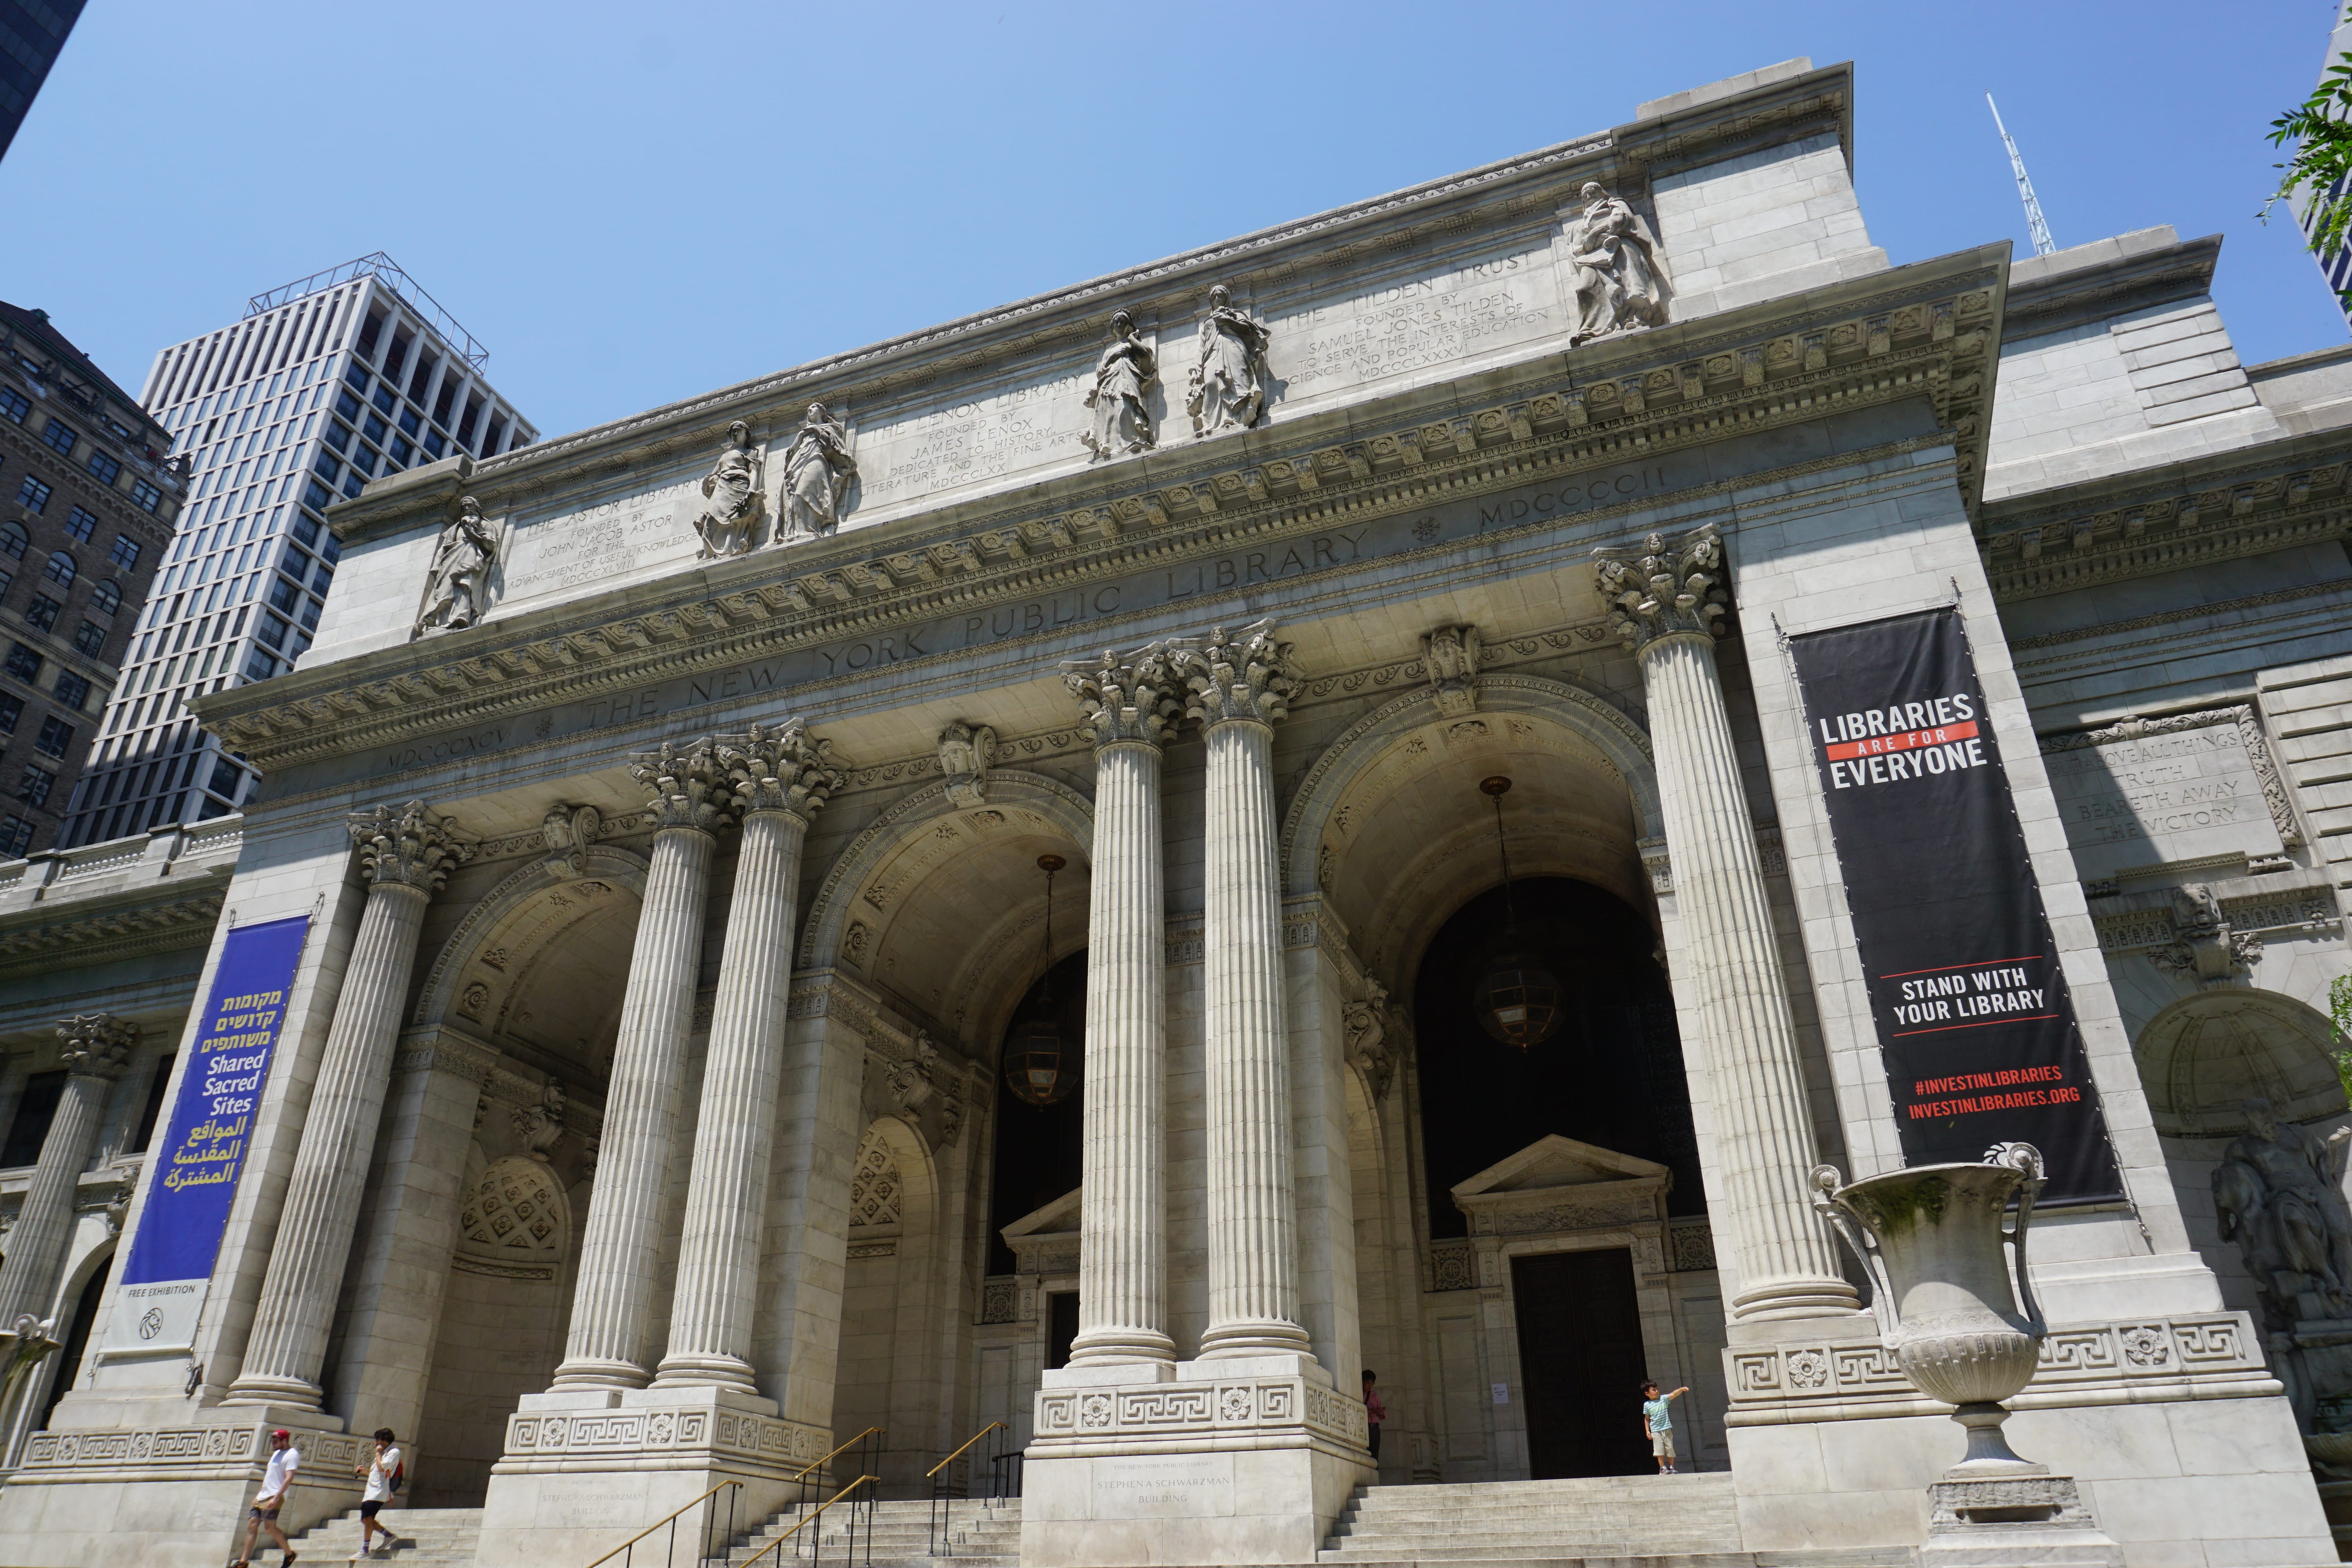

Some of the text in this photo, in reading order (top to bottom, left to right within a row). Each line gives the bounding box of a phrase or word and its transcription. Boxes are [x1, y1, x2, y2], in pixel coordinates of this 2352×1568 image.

[1280, 249, 1534, 330] THE TILDEN TRUST
[1308, 291, 1514, 354] SAMUEL JONES TILDEN
[1356, 293, 1458, 328] FOUNDED BY
[1282, 310, 1549, 387] SCIENCE AND POPULAR EDUCATION
[1298, 303, 1523, 370] TO SERVE THE INTERESTS OF
[1358, 344, 1468, 381] MDCCCLXXXVI
[870, 372, 1083, 442] THE LENOX LIBRARY
[910, 418, 1032, 459] JAMES LENOX
[928, 411, 1016, 442] FOUNDED BY
[860, 431, 1082, 497] LITERATURE AND THE FINE ARTS
[890, 452, 958, 477] DEDICATED
[967, 445, 984, 457] TO
[929, 463, 1006, 490] MDCCCLXX
[526, 475, 704, 537] THE ASTOR LIBRARY
[539, 515, 672, 559] JOHN JACOB ASTOR
[571, 512, 645, 539] FOUNDED BY
[508, 532, 697, 589] ADVANCEMENT OF USEFUL KNOWLEDGE
[578, 540, 625, 559] FOR THE
[561, 559, 635, 586] MDCCCXLVIII
[385, 466, 1665, 770] MDCCCXCV THE NEW YORK PUBLIC LIBRARY MDCCCCII
[1820, 693, 1974, 744] LIBRARIES
[1858, 729, 1946, 755] ARE FOR
[2050, 732, 2237, 776] BUT ABOVE ALL THINGS
[1830, 738, 1987, 789] EVERYONE
[2112, 765, 2185, 789] TRUTH
[2078, 780, 2238, 819] BEARETH AWAY
[2095, 806, 2238, 841] THE VICTORY
[1902, 967, 2027, 1000] STAND WITH
[221, 991, 281, 1012] מקומות
[1893, 989, 2044, 1025] YOUR LIBRARY
[215, 1011, 276, 1031] קדושים
[200, 1031, 271, 1053] משותפים
[207, 1048, 267, 1074] Shared
[202, 1070, 260, 1096] Sacred
[1915, 1065, 2062, 1096] #INVESTINLIBRARIES
[210, 1096, 252, 1116] Sites
[1909, 1087, 2081, 1119] INVESTINLIBRARIES.ORG
[187, 1116, 248, 1147] المواقع
[173, 1139, 242, 1164] المقدسة
[164, 1162, 236, 1192] المشتركة
[127, 1285, 196, 1298] FREE EXHIBITION
[1097, 1481, 1143, 1489] STEPHEN
[1156, 1477, 1230, 1487] SCHWARZMAN
[1139, 1494, 1187, 1503] BUILDING
